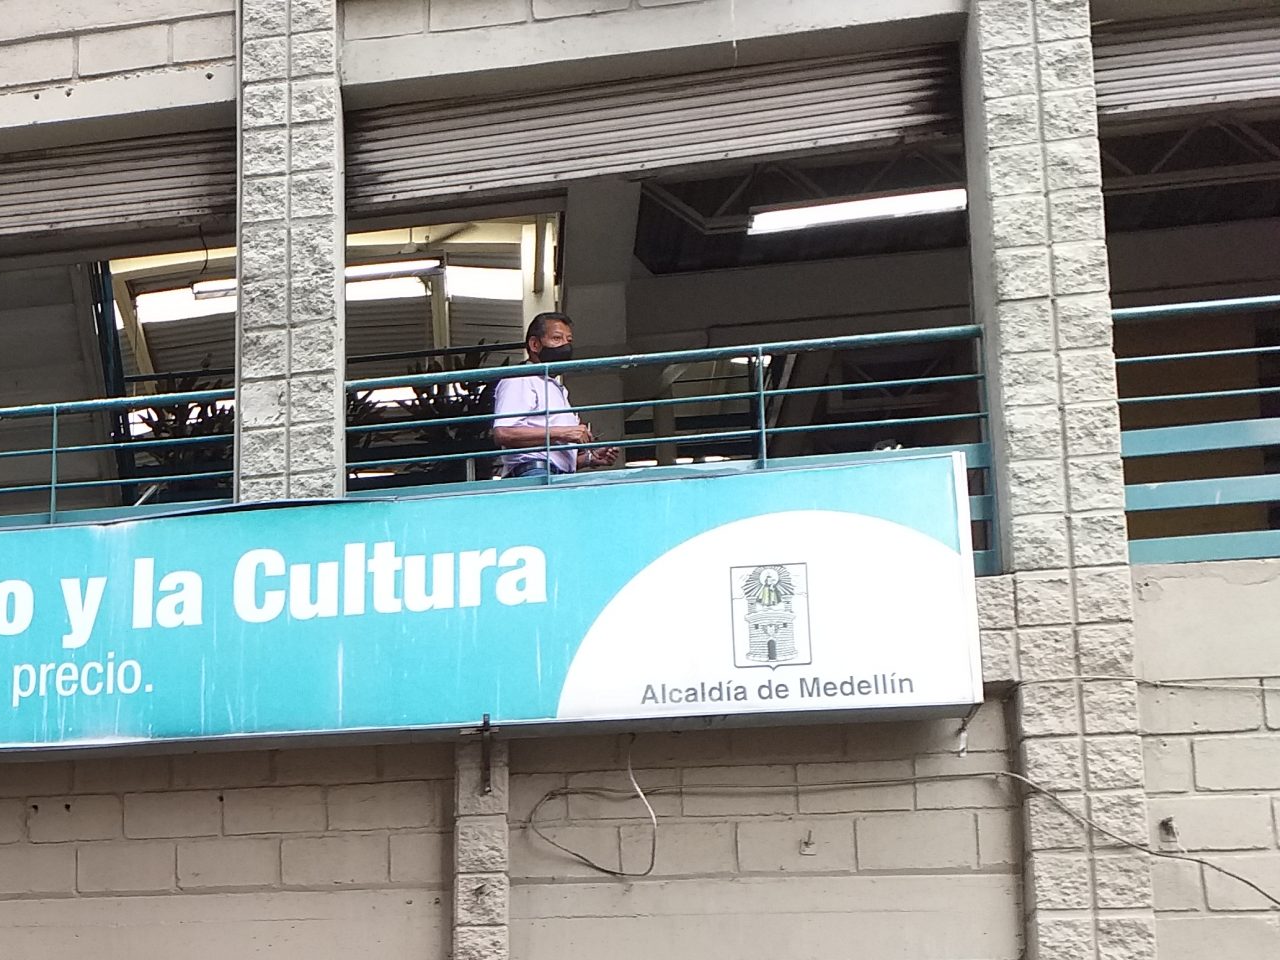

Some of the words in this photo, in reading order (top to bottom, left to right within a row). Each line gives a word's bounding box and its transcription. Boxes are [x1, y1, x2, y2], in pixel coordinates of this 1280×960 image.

[60, 576, 108, 648] y
[132, 557, 203, 629] la
[233, 541, 548, 623] Cultura
[12, 651, 154, 708] precio.
[641, 680, 748, 705] Alcaldía
[757, 679, 790, 700] de
[799, 672, 914, 698] Medellín
